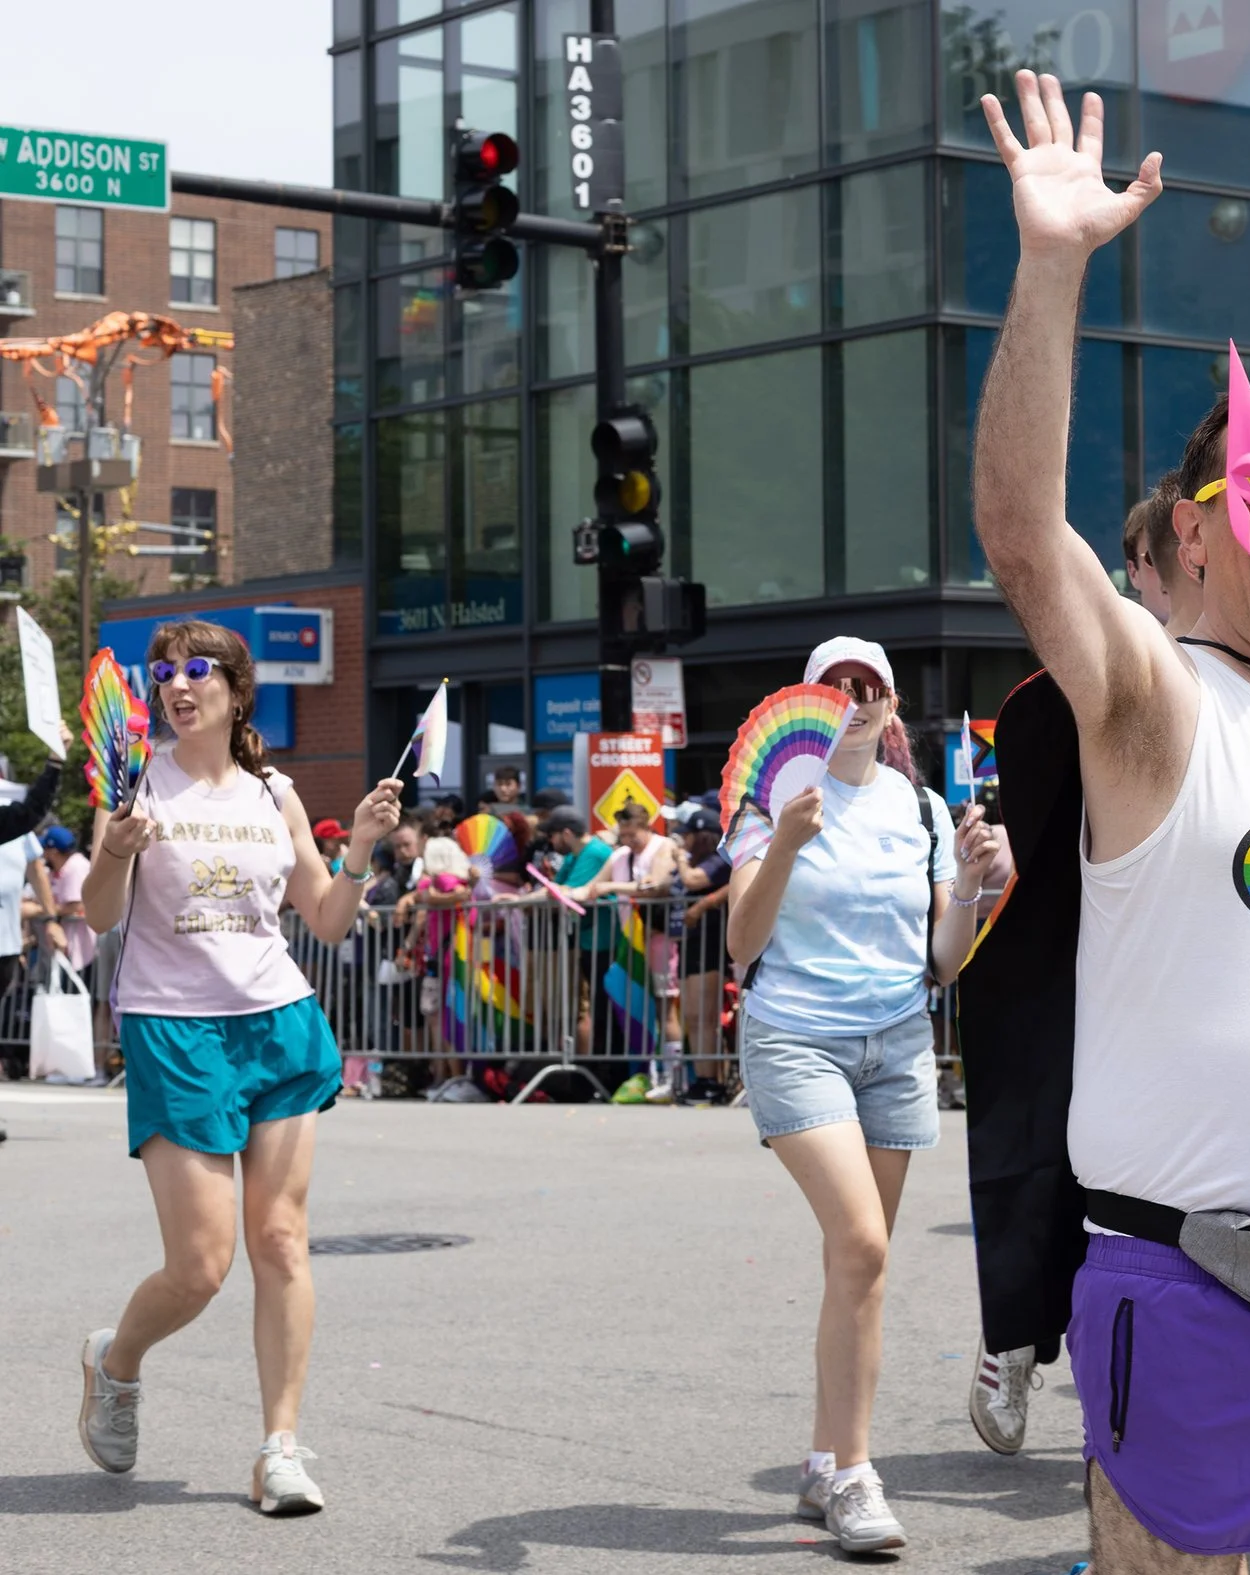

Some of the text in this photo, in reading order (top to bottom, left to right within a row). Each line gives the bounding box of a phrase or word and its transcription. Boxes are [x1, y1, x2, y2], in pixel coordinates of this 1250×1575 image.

[566, 36, 594, 208] HA3601
[17, 136, 131, 174] ADDISON
[138, 151, 160, 172] ST
[35, 170, 121, 197] 3600 N
[450, 597, 505, 626] Halsted
[599, 736, 651, 753] STREET
[591, 753, 662, 768] CROSSING
